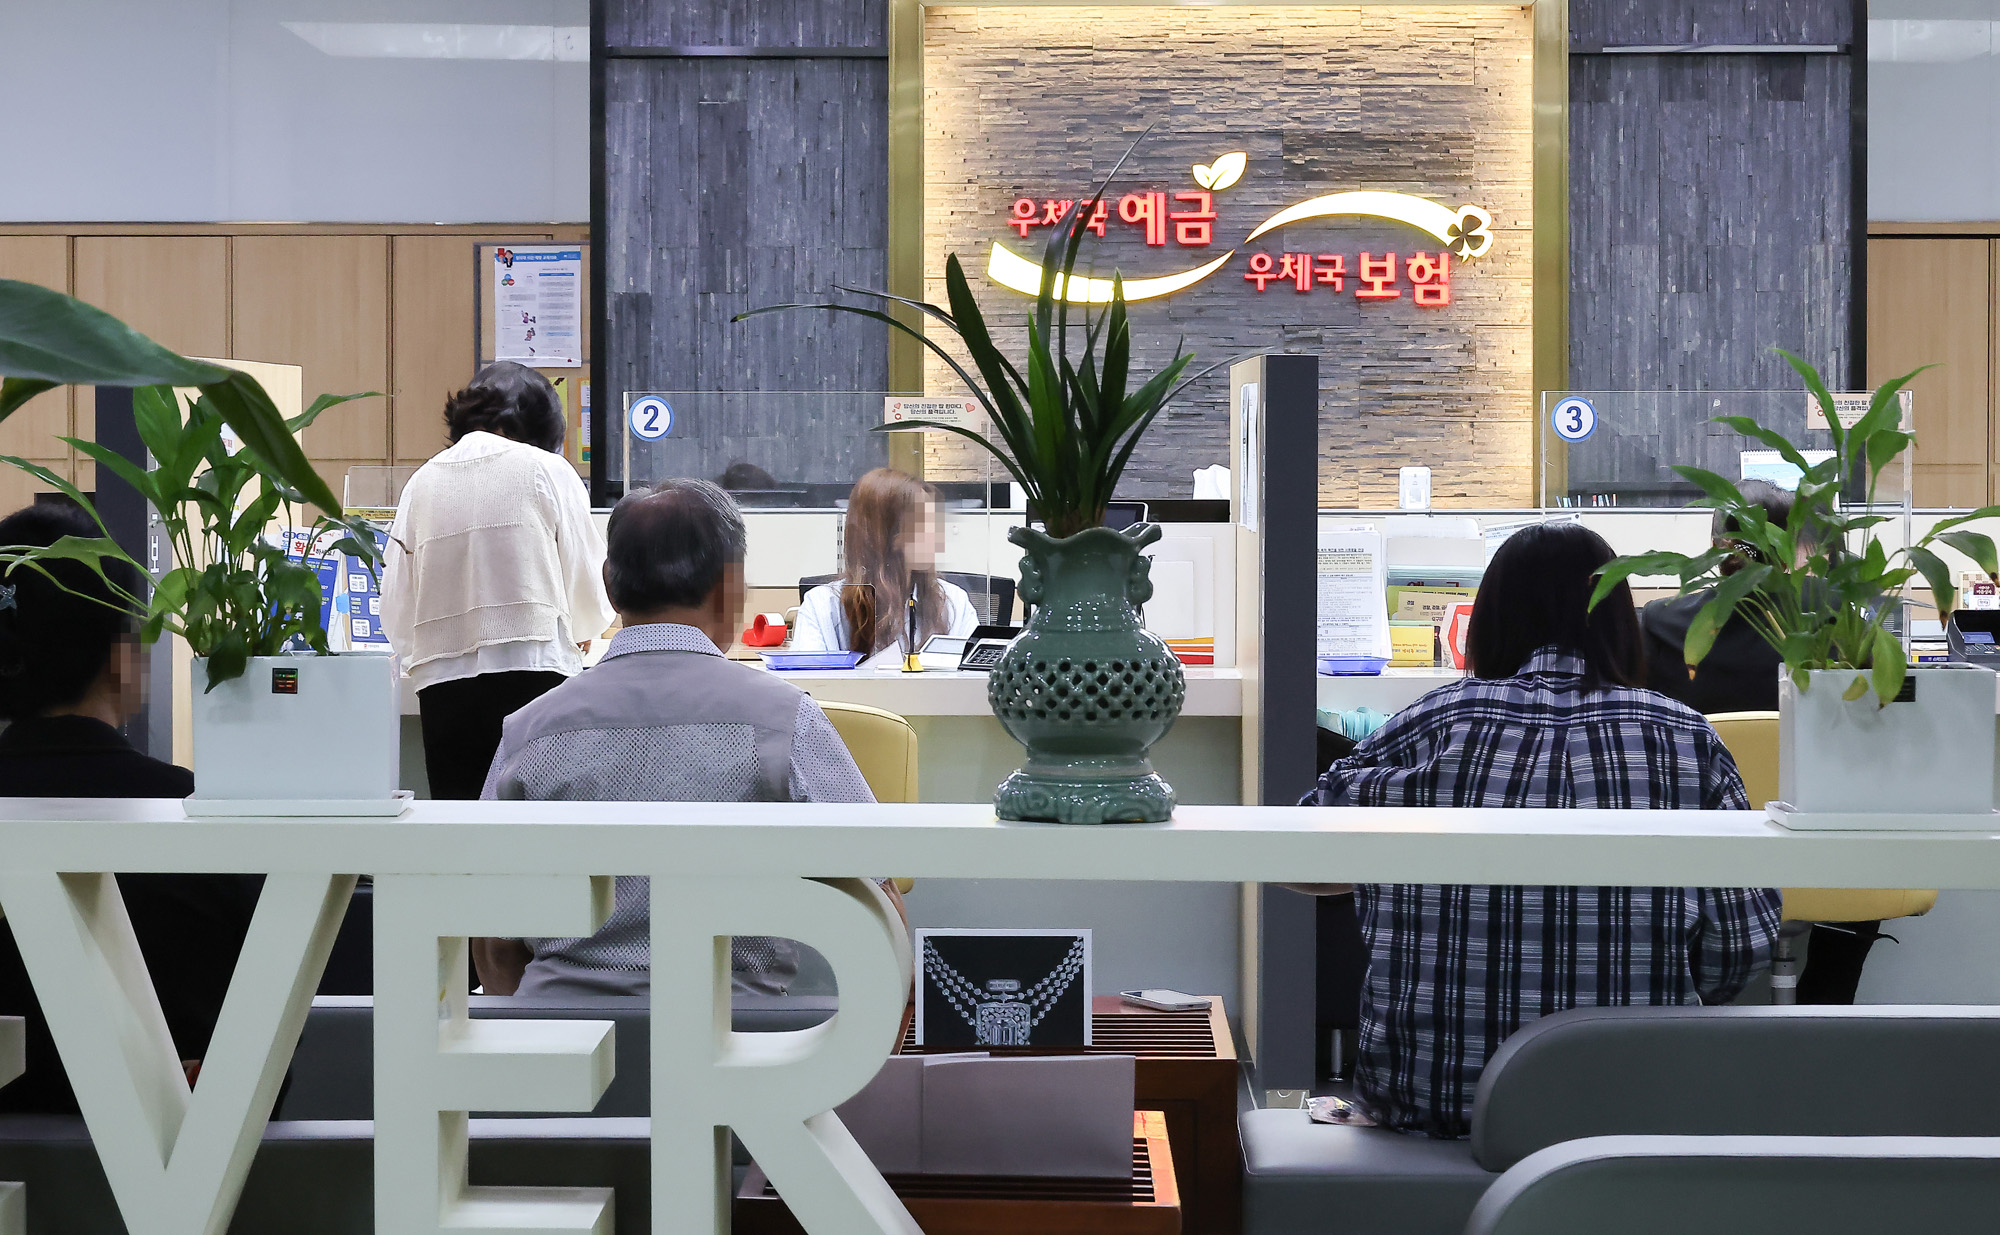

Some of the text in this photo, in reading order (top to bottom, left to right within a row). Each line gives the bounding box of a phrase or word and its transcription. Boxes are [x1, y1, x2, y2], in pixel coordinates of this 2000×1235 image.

[1007, 192, 1218, 245] 우체국 예금
[1244, 251, 1450, 305] 우체국 보험
[643, 404, 659, 431] 2
[1566, 405, 1583, 433] 3
[0, 870, 925, 1235] VER
